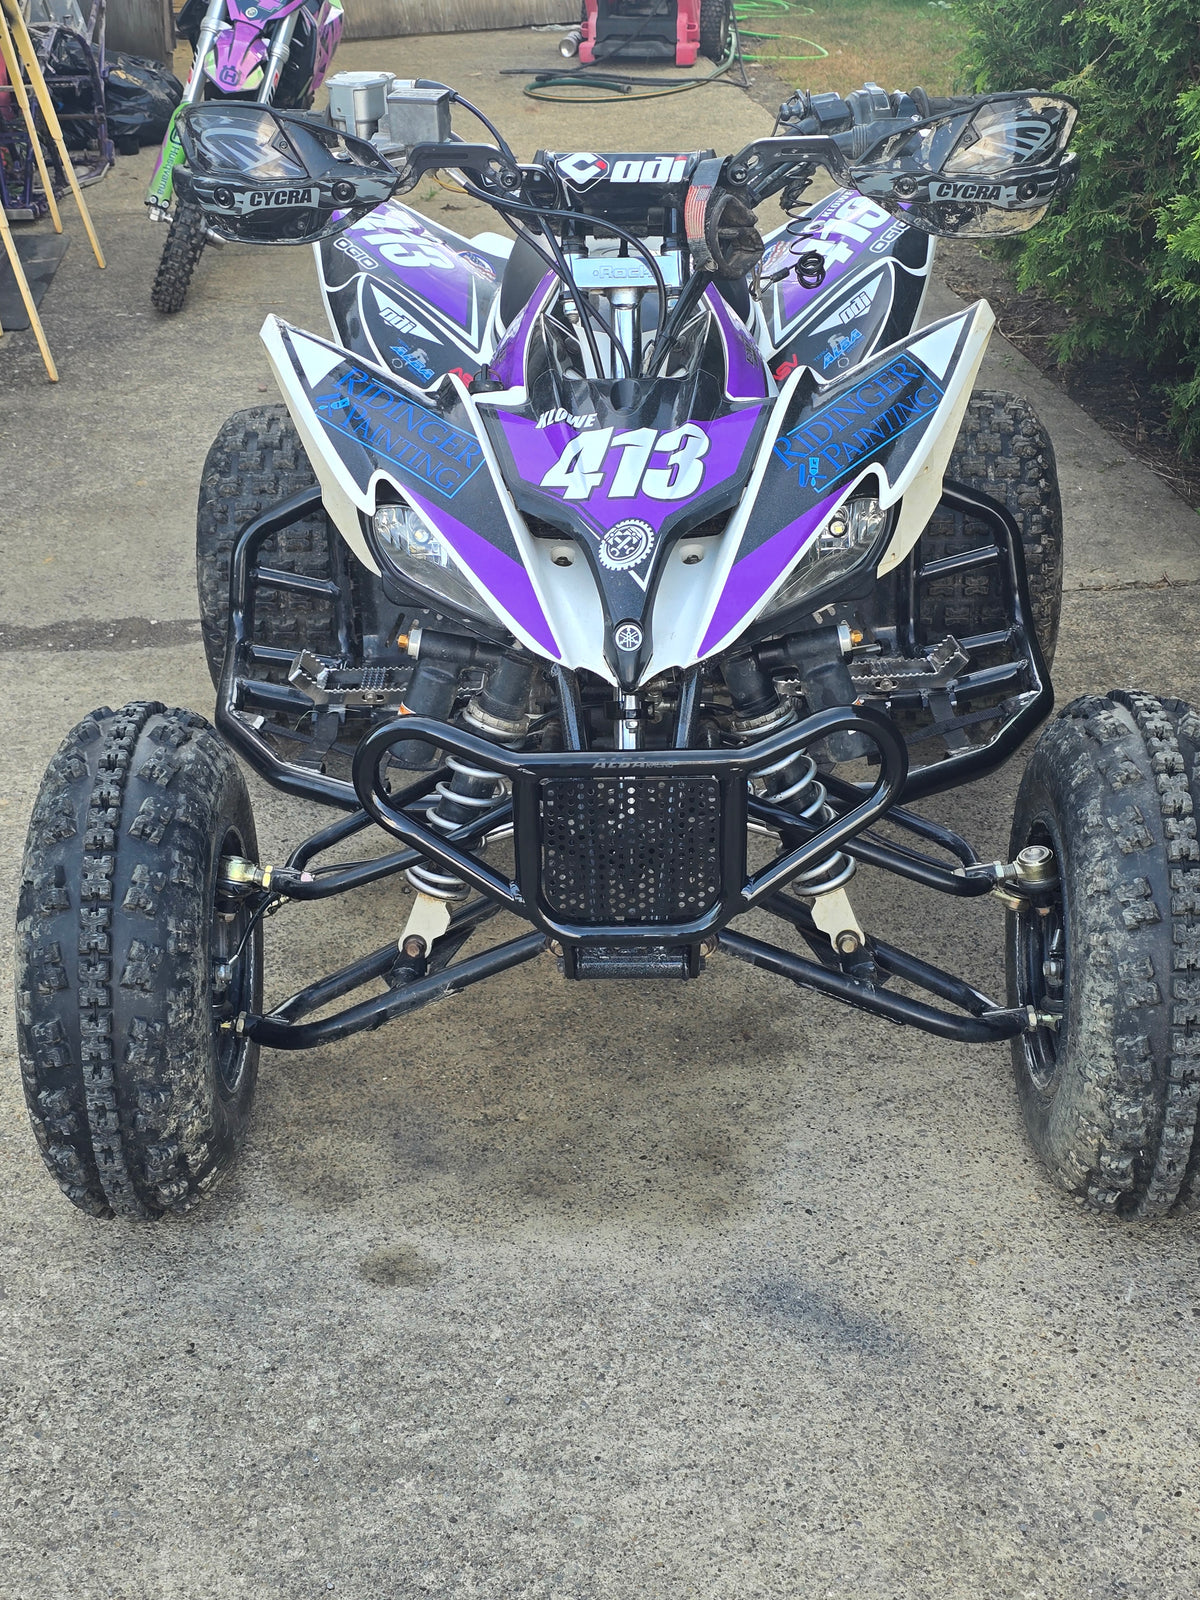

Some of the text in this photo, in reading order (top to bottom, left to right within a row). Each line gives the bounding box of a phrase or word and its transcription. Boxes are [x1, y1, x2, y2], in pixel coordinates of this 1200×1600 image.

[157, 146, 179, 195] Husqvarna
[610, 156, 687, 183] odi
[249, 188, 313, 207] CYCRA
[935, 182, 1002, 200] CYCRA
[334, 238, 378, 269] OGIO
[379, 307, 418, 335] odi
[839, 291, 873, 325] odi
[389, 345, 435, 380] ALBA
[823, 328, 862, 370] ALBA
[333, 366, 482, 469] RIDINGER
[535, 407, 598, 429] KLOWE
[773, 362, 920, 471] RIDINGER
[820, 385, 939, 472] PAINTING
[340, 403, 461, 489] PAINTING
[539, 422, 710, 500] 413
